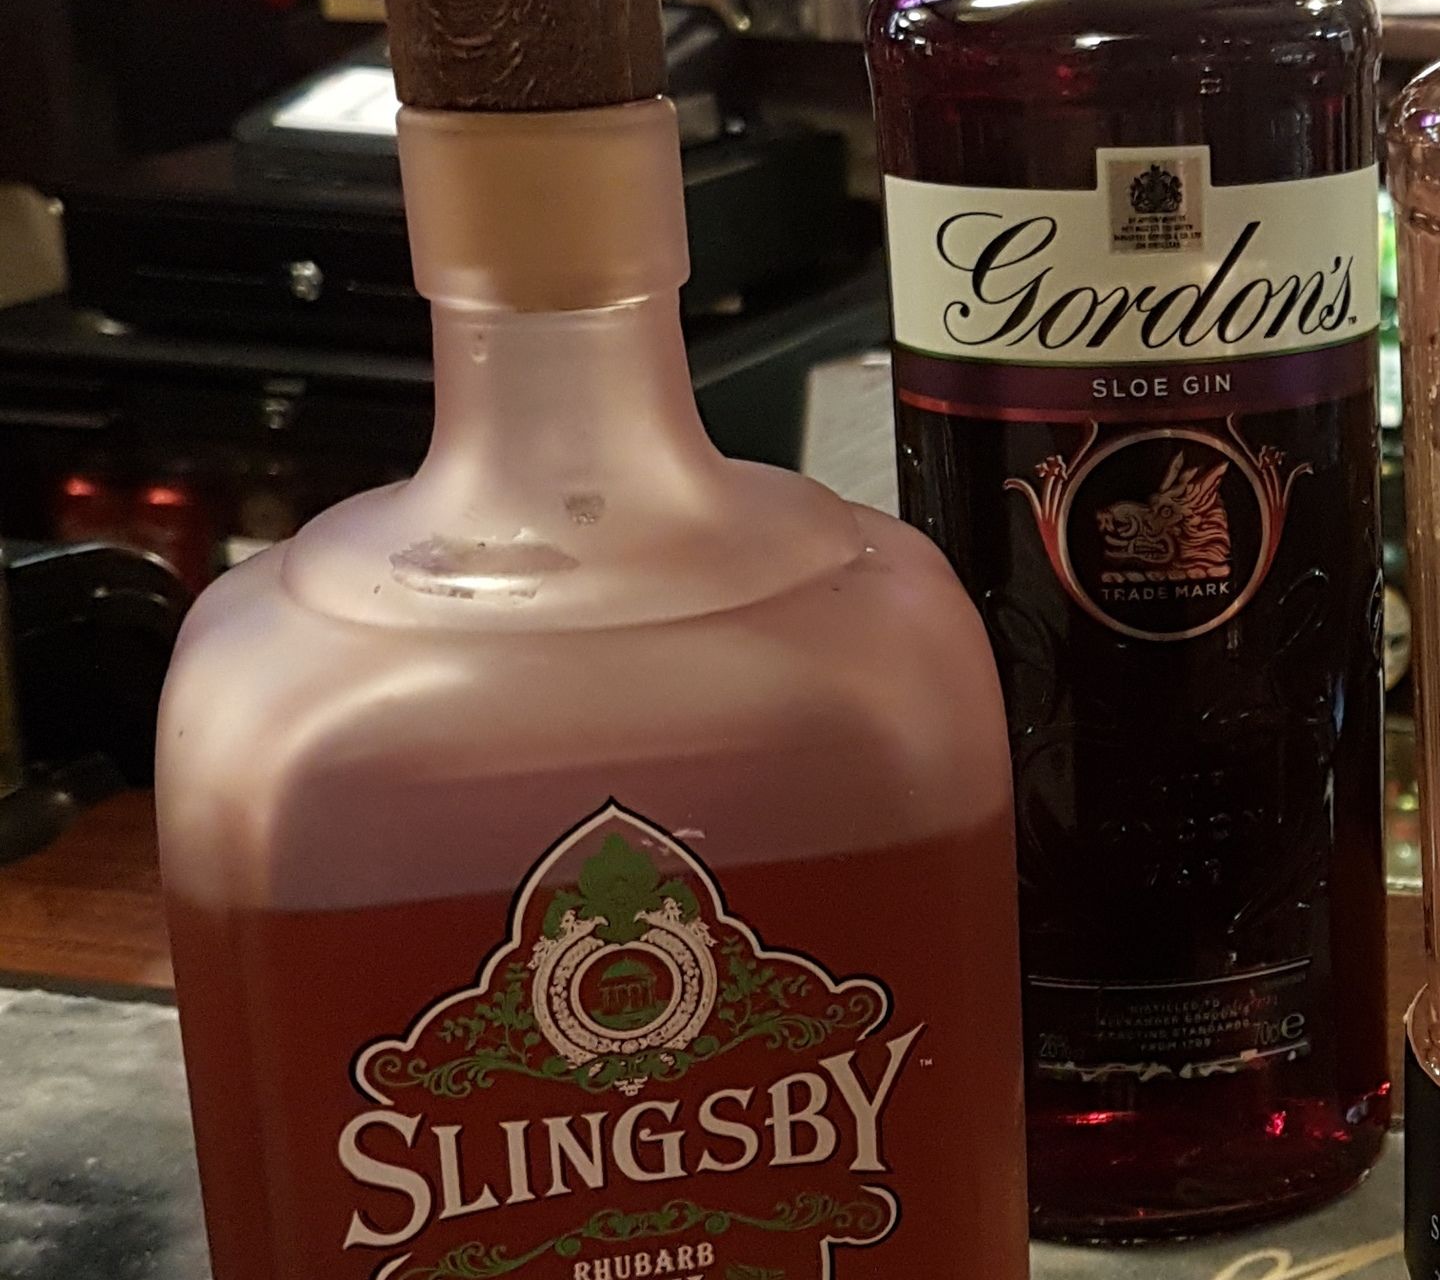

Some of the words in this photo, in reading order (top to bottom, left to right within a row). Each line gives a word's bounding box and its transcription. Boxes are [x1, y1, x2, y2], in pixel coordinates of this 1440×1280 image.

[936, 211, 1354, 350] Gordon's
[1092, 378, 1170, 399] SLOE
[1183, 373, 1233, 395] GIN
[1100, 584, 1169, 602] TRADE
[1175, 581, 1231, 600] MARK
[337, 1022, 926, 1251] SLINGSBY
